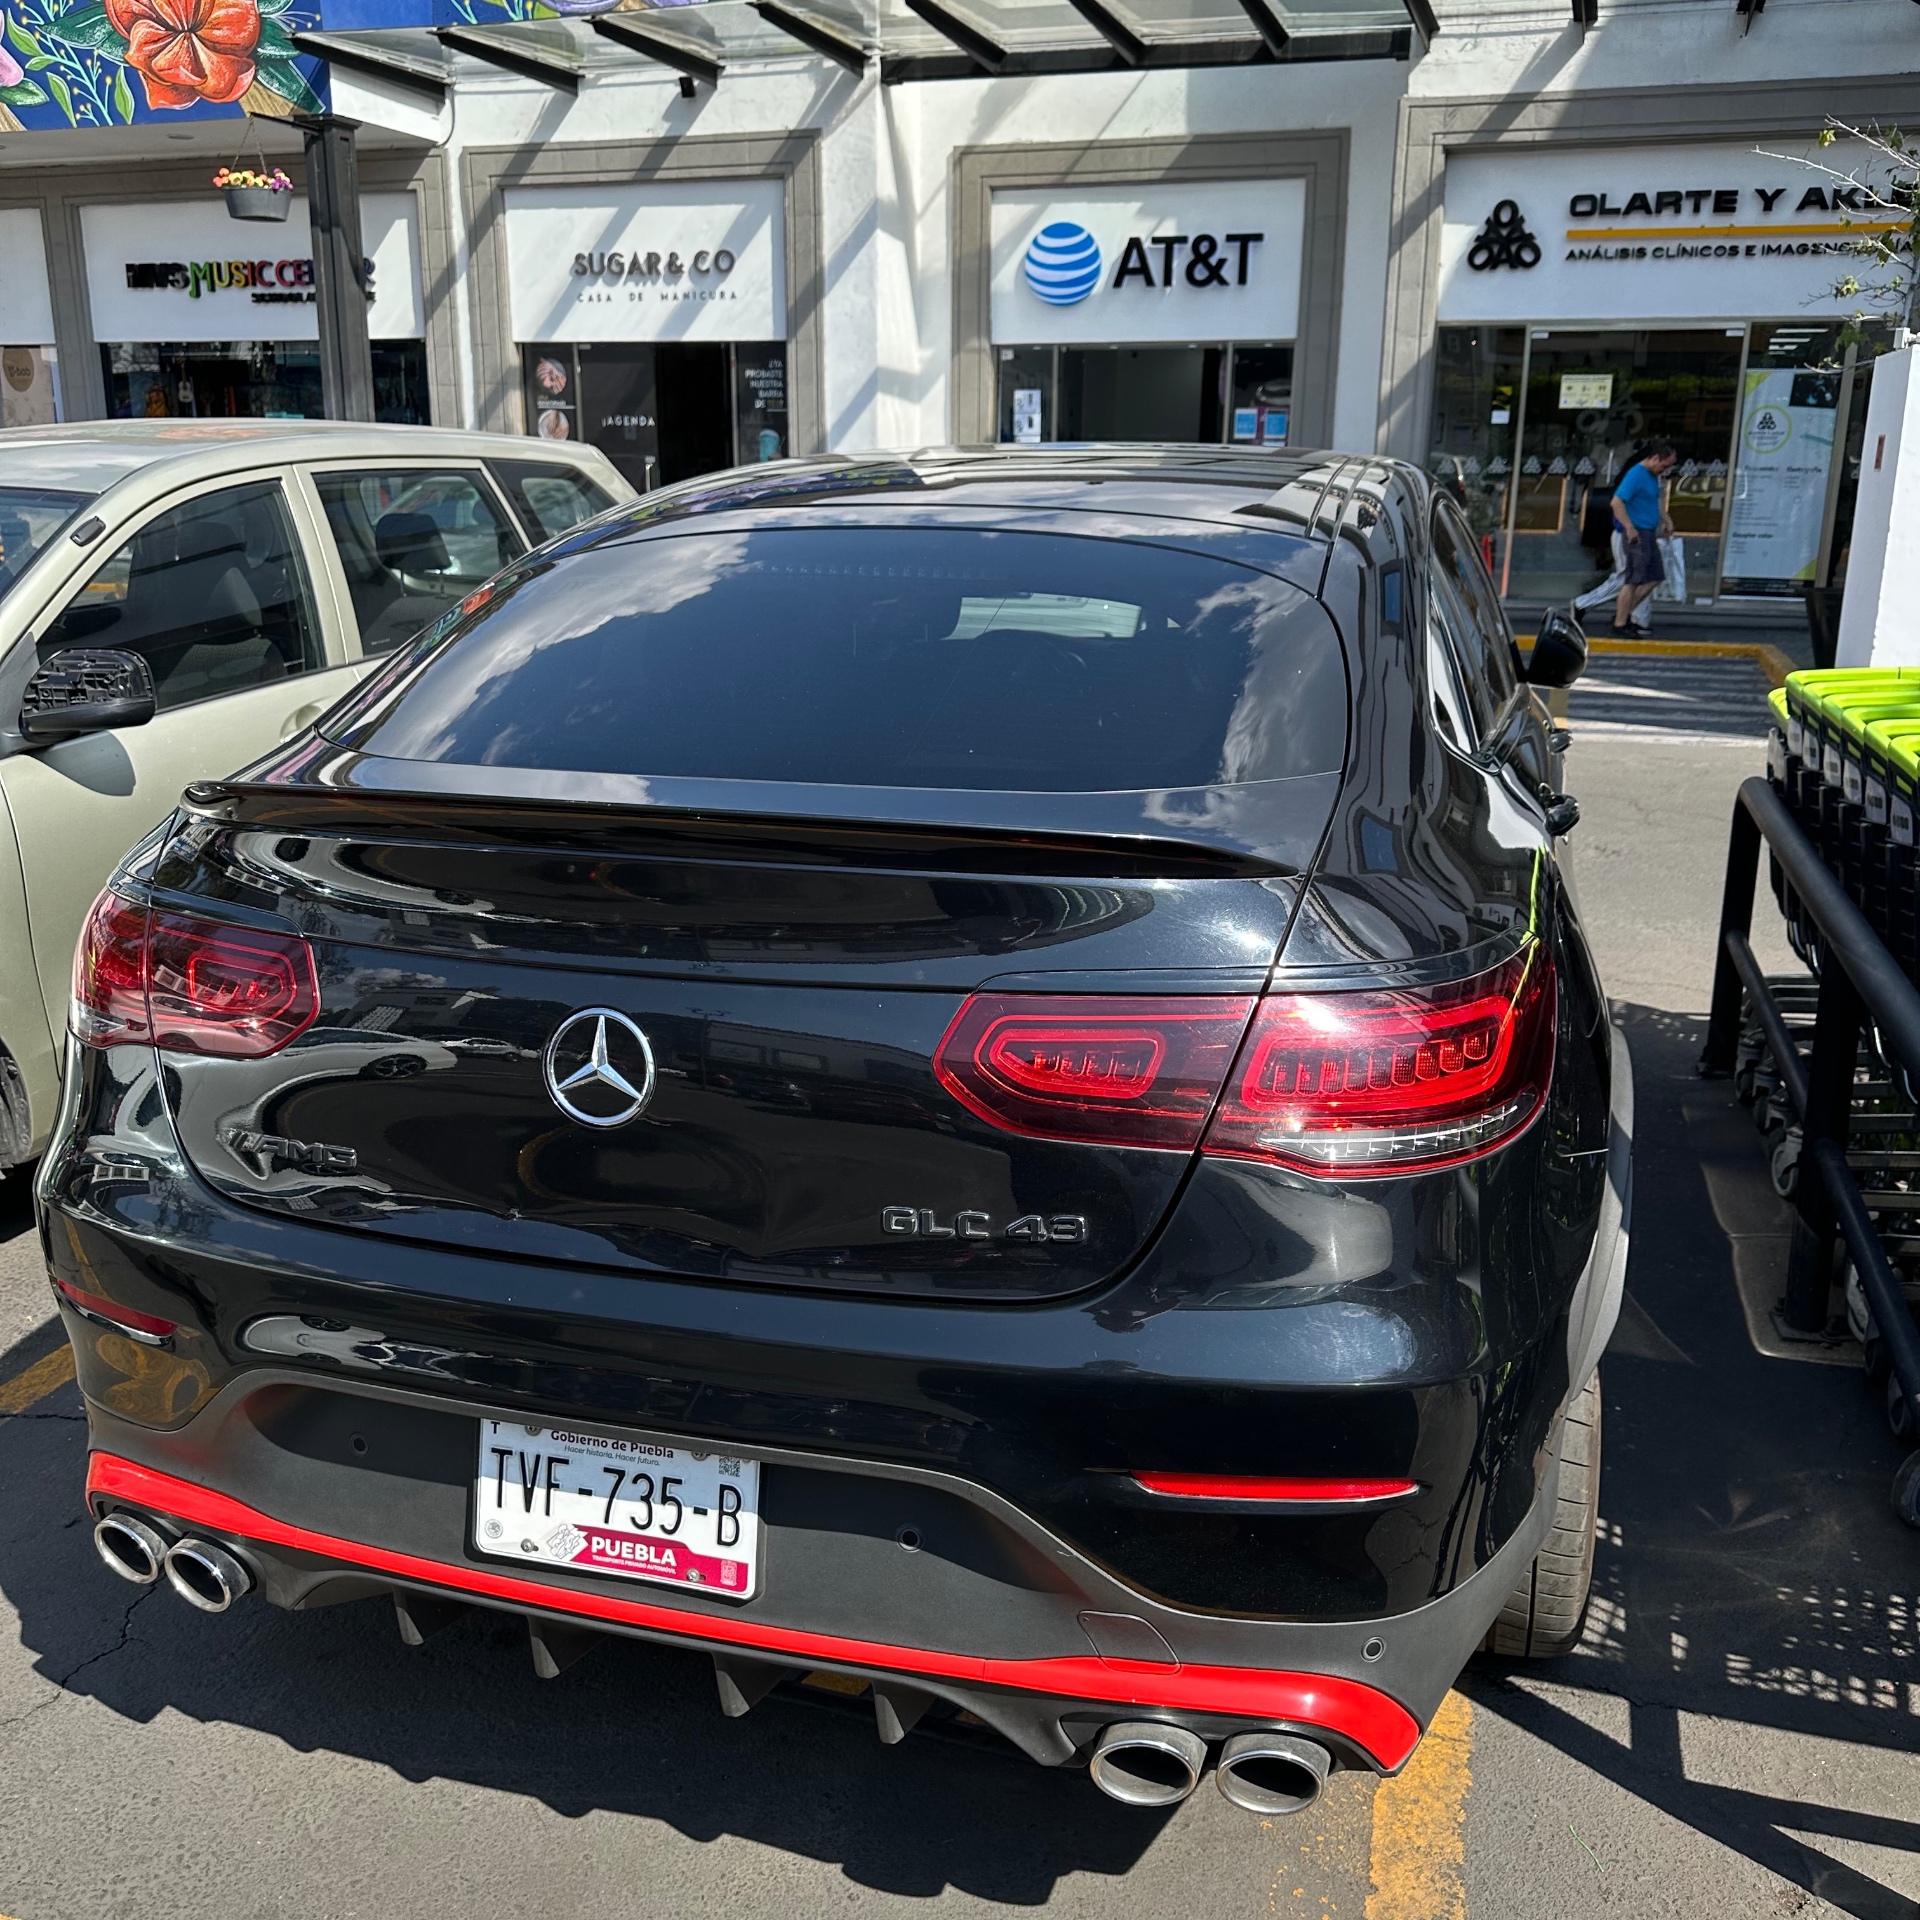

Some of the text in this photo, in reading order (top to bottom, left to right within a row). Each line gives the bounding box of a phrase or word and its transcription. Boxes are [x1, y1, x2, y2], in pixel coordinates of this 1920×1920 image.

[1569, 190, 1739, 217] OLARTE
[1754, 188, 1787, 212] Y
[1112, 233, 1264, 289] AT&T
[1565, 243, 1647, 261] ANÁLISIS
[1651, 242, 1740, 258] CLÍNICOS
[1744, 244, 1756, 256] E
[188, 258, 273, 299] MUSIC
[576, 290, 738, 303] CASA DE MANICURA
[880, 1205, 1088, 1243] GLC 43
[490, 1420, 501, 1435] T
[550, 1429, 674, 1459] Gobierno de Puebla
[563, 1444, 586, 1455] Hacer
[615, 1451, 637, 1463] Hacer
[490, 1446, 743, 1547] TVF-735-B
[590, 1535, 678, 1567] PUEBLA
